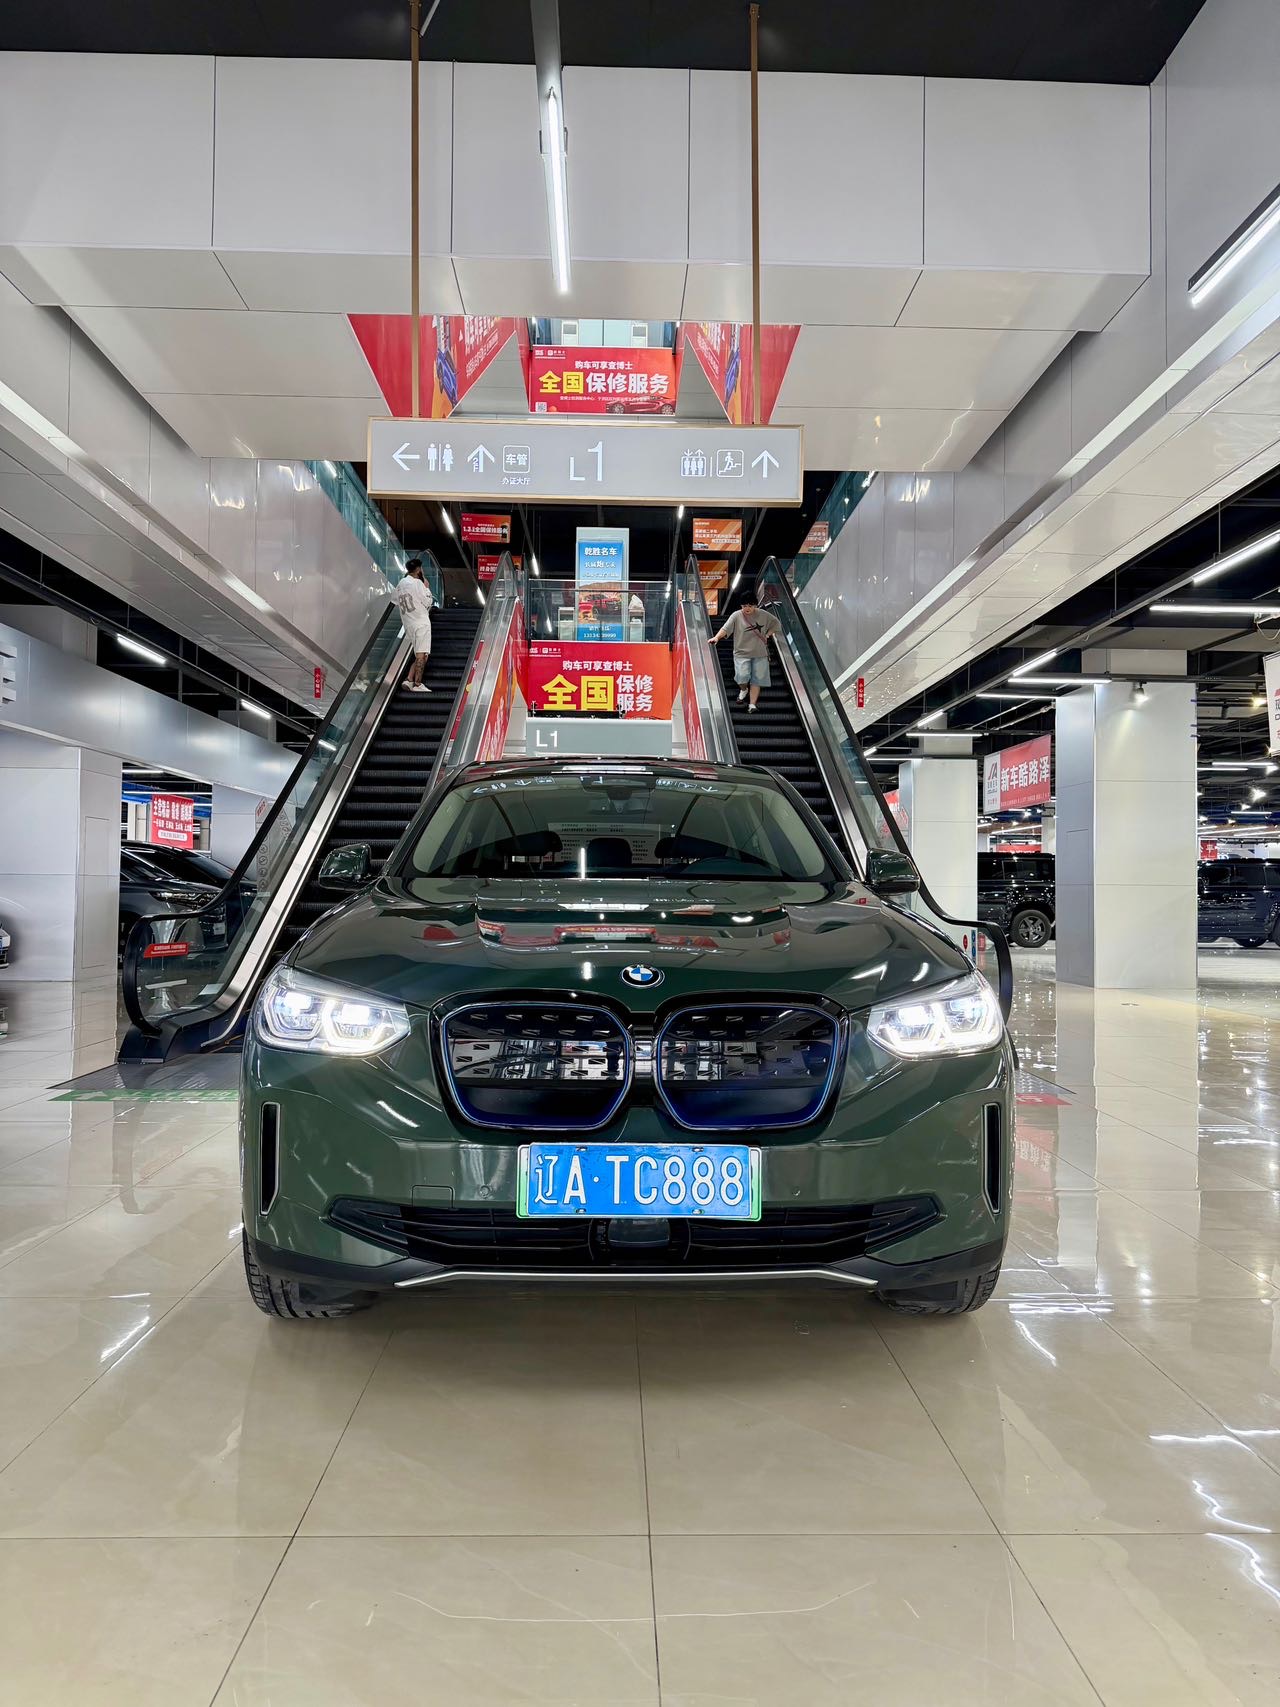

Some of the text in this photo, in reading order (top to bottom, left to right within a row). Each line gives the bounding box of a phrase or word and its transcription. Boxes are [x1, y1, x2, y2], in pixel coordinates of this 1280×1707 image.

[575, 360, 633, 370] 购车可享查博士
[538, 370, 669, 395] 全国保修服务
[505, 453, 528, 466] 车管
[569, 441, 603, 482] L1
[501, 477, 531, 485] 办证大厅
[562, 660, 633, 671] 购车可享查博士
[541, 674, 614, 711] 全国
[616, 675, 653, 693] 保修
[617, 693, 653, 712] 服务
[536, 730, 558, 747] L1
[1001, 756, 1050, 792] 新车酷路泽
[534, 1155, 744, 1206] 辽A·TC888
